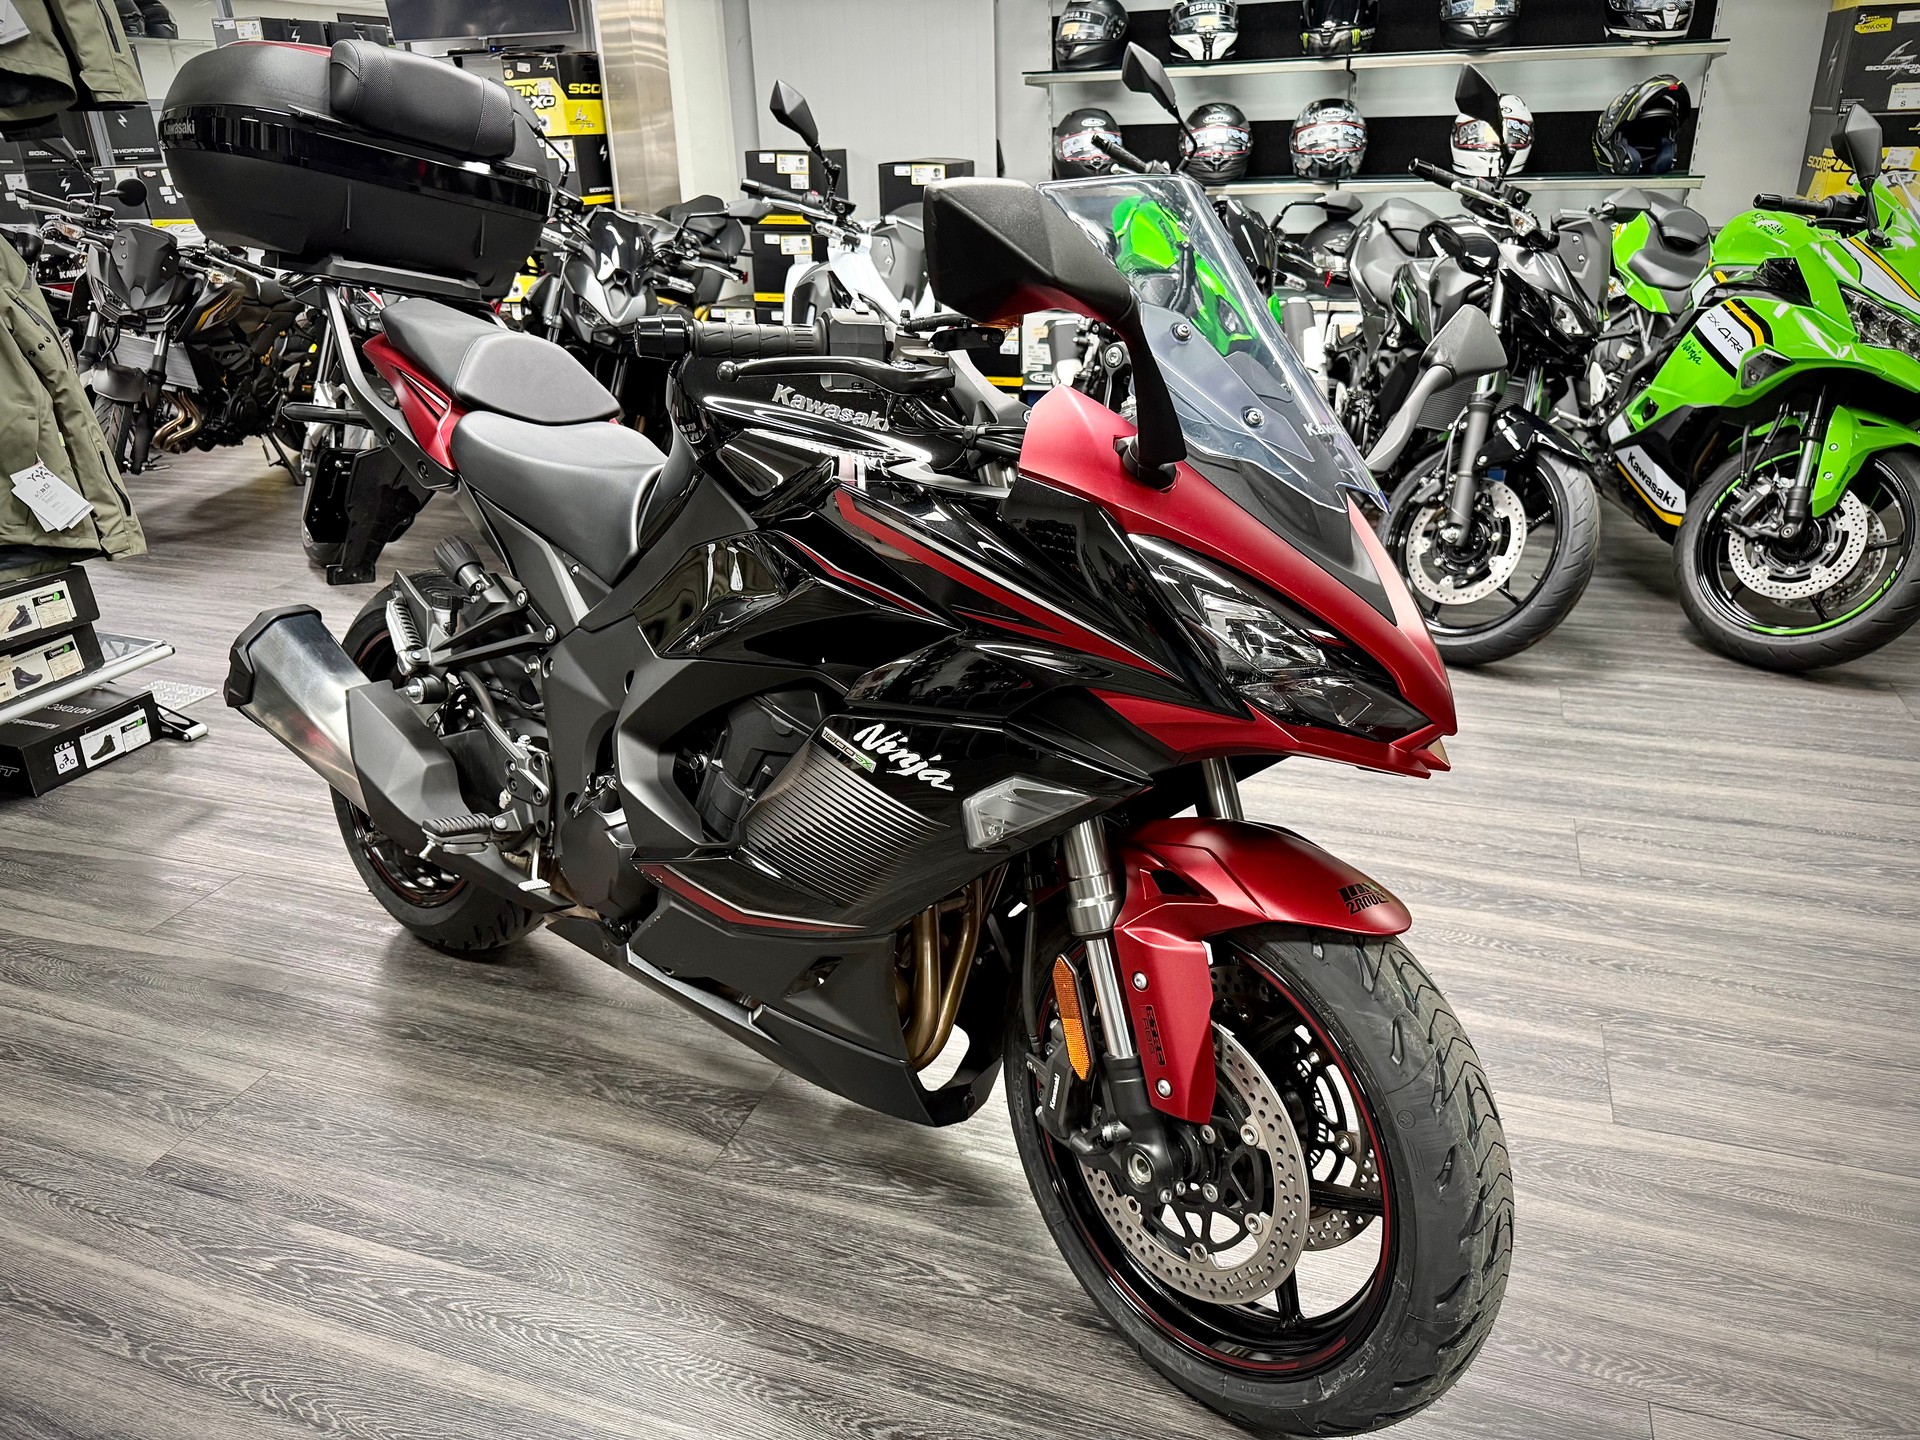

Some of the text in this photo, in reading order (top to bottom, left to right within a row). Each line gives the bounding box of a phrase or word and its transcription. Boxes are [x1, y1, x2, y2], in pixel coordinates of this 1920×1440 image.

[162, 119, 196, 135] Kawasaki
[1681, 339, 1703, 366] Ninja
[771, 383, 890, 432] Kawasaki
[1627, 451, 1678, 509] Kawasaki
[853, 722, 954, 791] Ninja
[1049, 1073, 1061, 1110] Kawasaki
